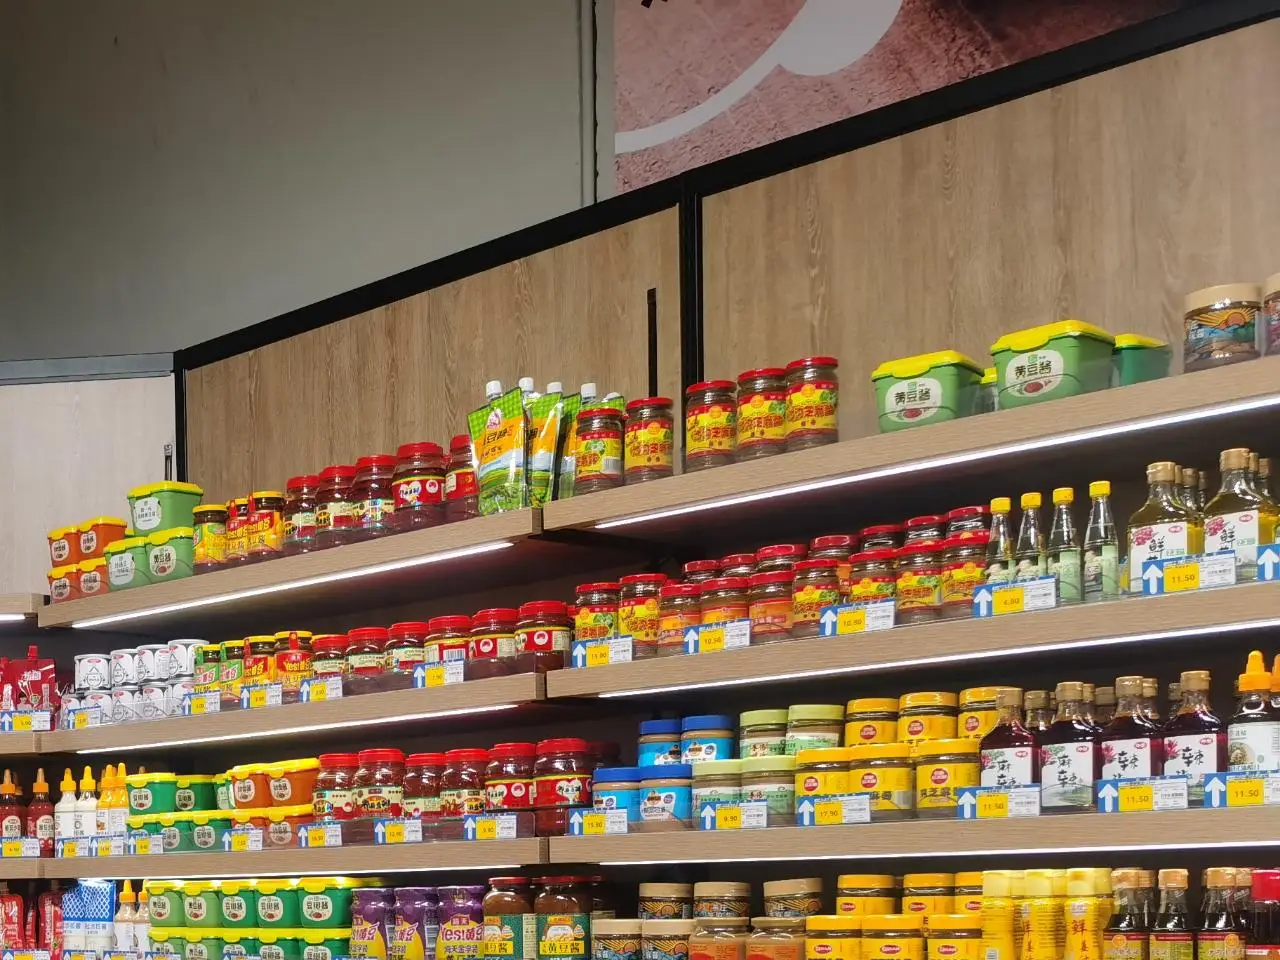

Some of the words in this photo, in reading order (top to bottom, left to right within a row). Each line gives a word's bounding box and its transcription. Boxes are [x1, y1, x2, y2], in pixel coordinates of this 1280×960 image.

[1014, 361, 1052, 379] 黄豆酱
[894, 388, 931, 406] 黄豆酱
[1172, 574, 1195, 583] 11.50
[1233, 789, 1260, 799] 11.50
